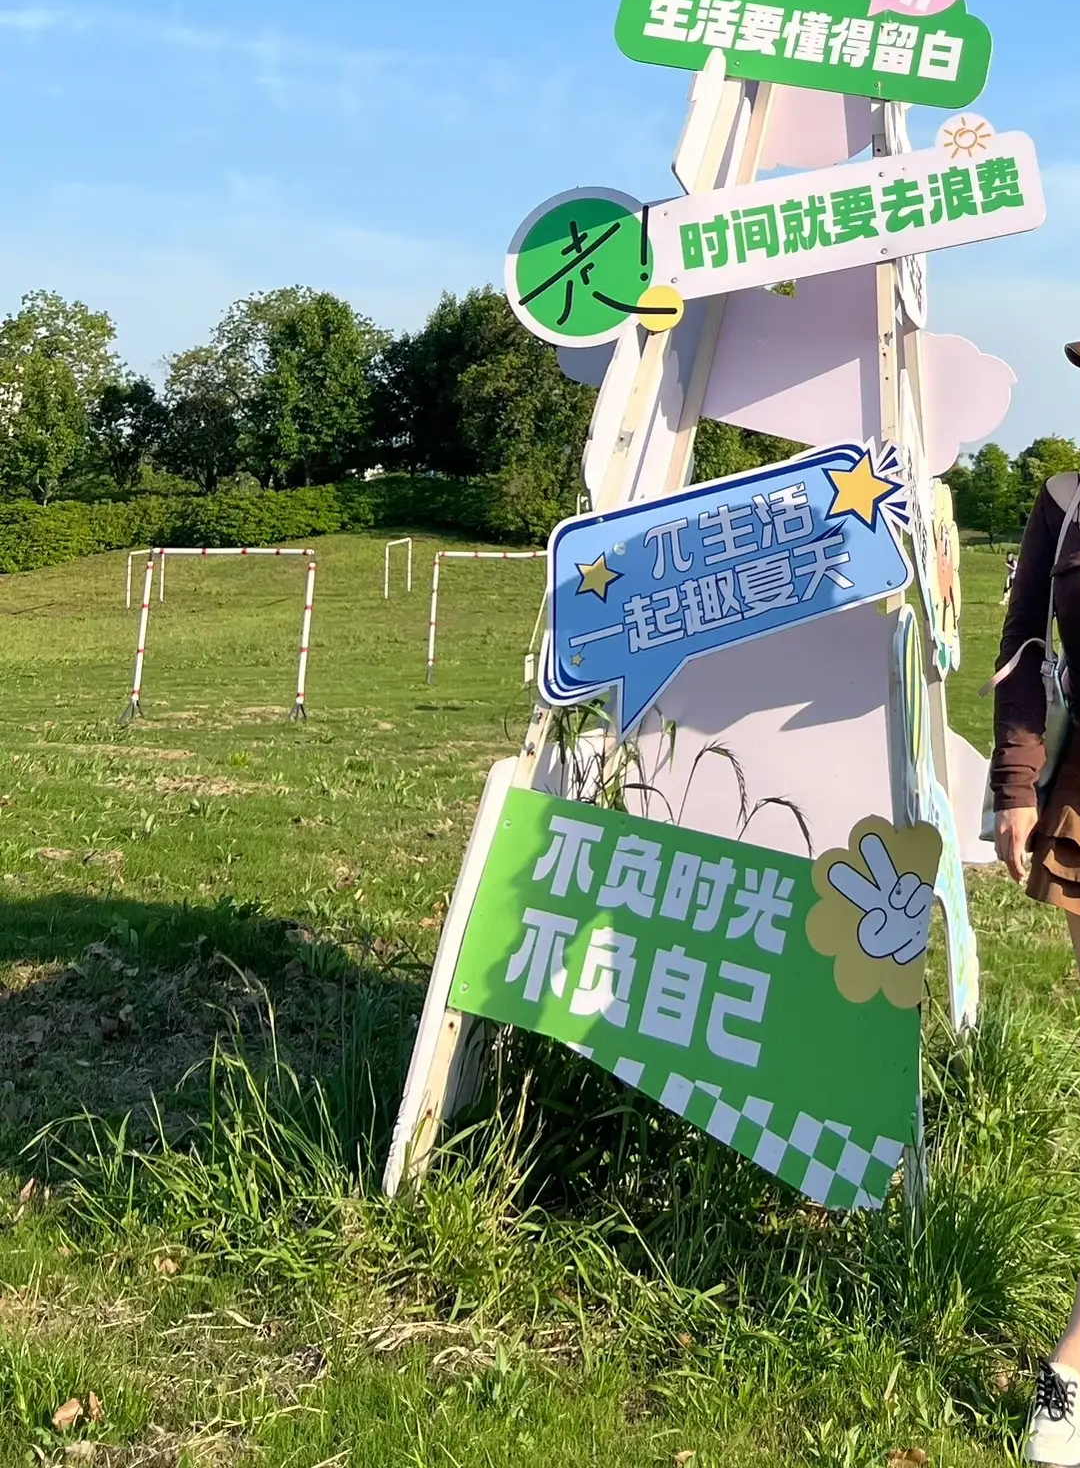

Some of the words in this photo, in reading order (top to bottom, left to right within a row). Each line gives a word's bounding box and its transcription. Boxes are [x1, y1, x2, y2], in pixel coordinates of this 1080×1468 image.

[680, 156, 1025, 271] 时间就要去浪费
[569, 534, 855, 654] 一起趣夏天
[532, 814, 795, 955] 不负时光
[506, 908, 771, 1067] 不负自己
